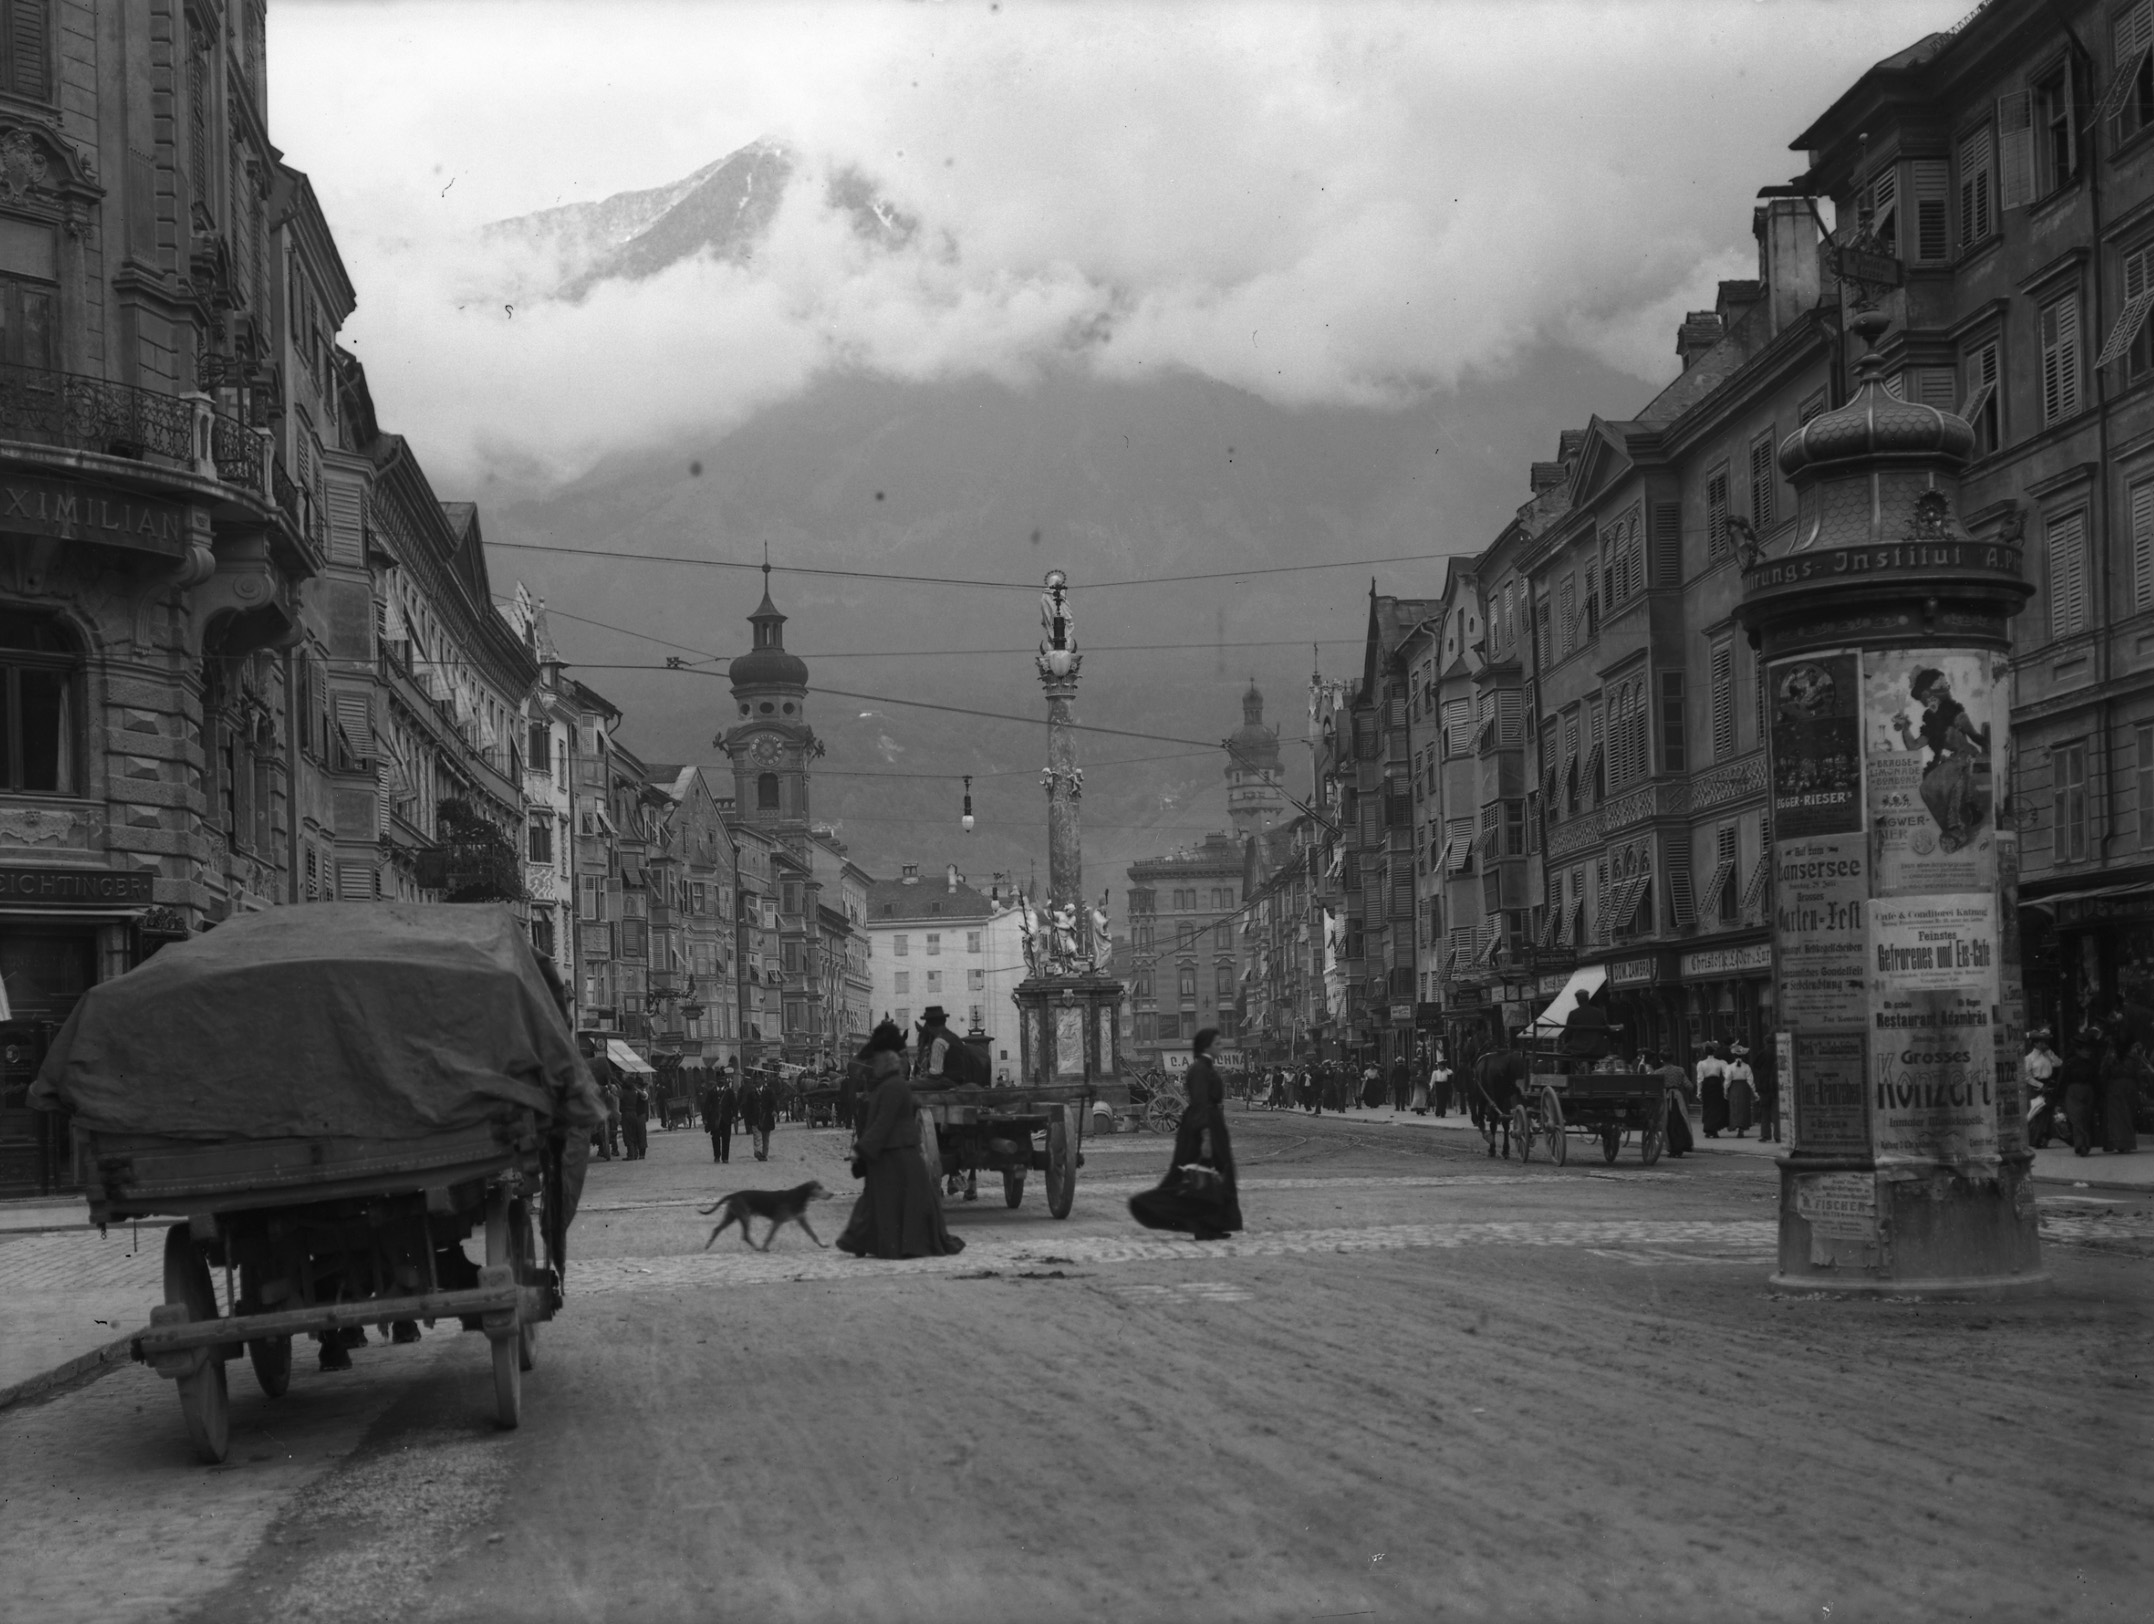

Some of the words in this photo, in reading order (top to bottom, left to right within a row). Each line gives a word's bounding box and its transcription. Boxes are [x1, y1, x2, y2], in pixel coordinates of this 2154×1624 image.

[3, 486, 180, 542] XIMILIAN
[1898, 911, 1906, 920] &
[1918, 930, 1957, 942] Feinstes
[1877, 943, 1933, 972] Gefrorenes
[1936, 940, 1953, 969] und
[1876, 1011, 1937, 1028] Restaurant
[1940, 1010, 1987, 1026] Adambräu
[1900, 1050, 1971, 1064] Grosses
[1876, 1052, 1992, 1109] Konzert
